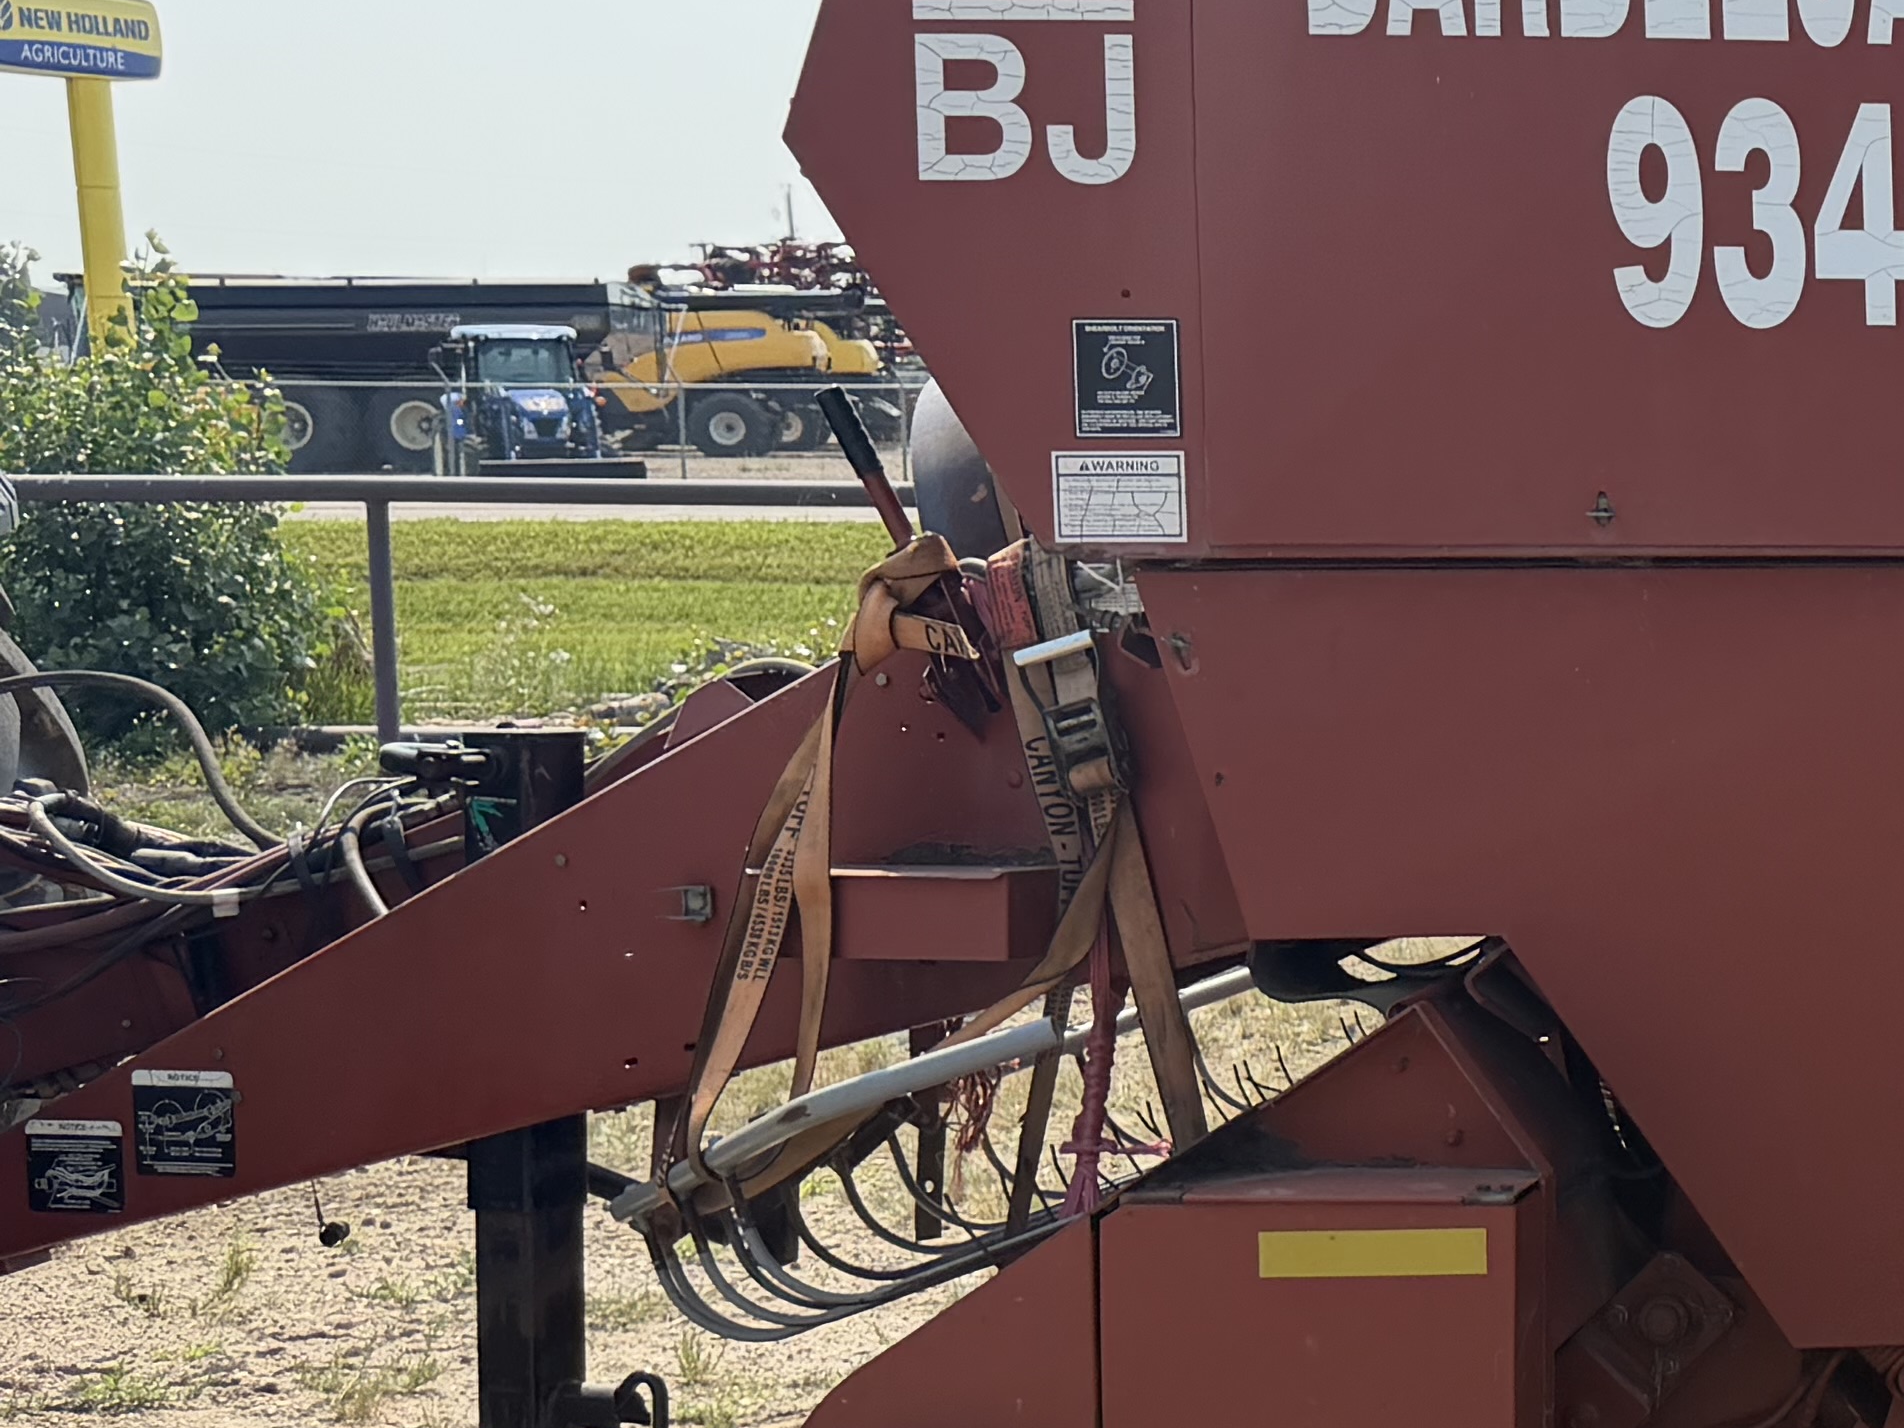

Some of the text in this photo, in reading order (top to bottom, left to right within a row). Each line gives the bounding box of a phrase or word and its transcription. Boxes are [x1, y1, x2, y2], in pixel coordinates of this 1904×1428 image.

[18, 6, 149, 41] NEW HOLLAND
[21, 43, 125, 70] AGRICULTURE
[914, 33, 1137, 185] BJ
[1092, 460, 1160, 472] WARNING
[1025, 736, 1078, 836] CANYON
